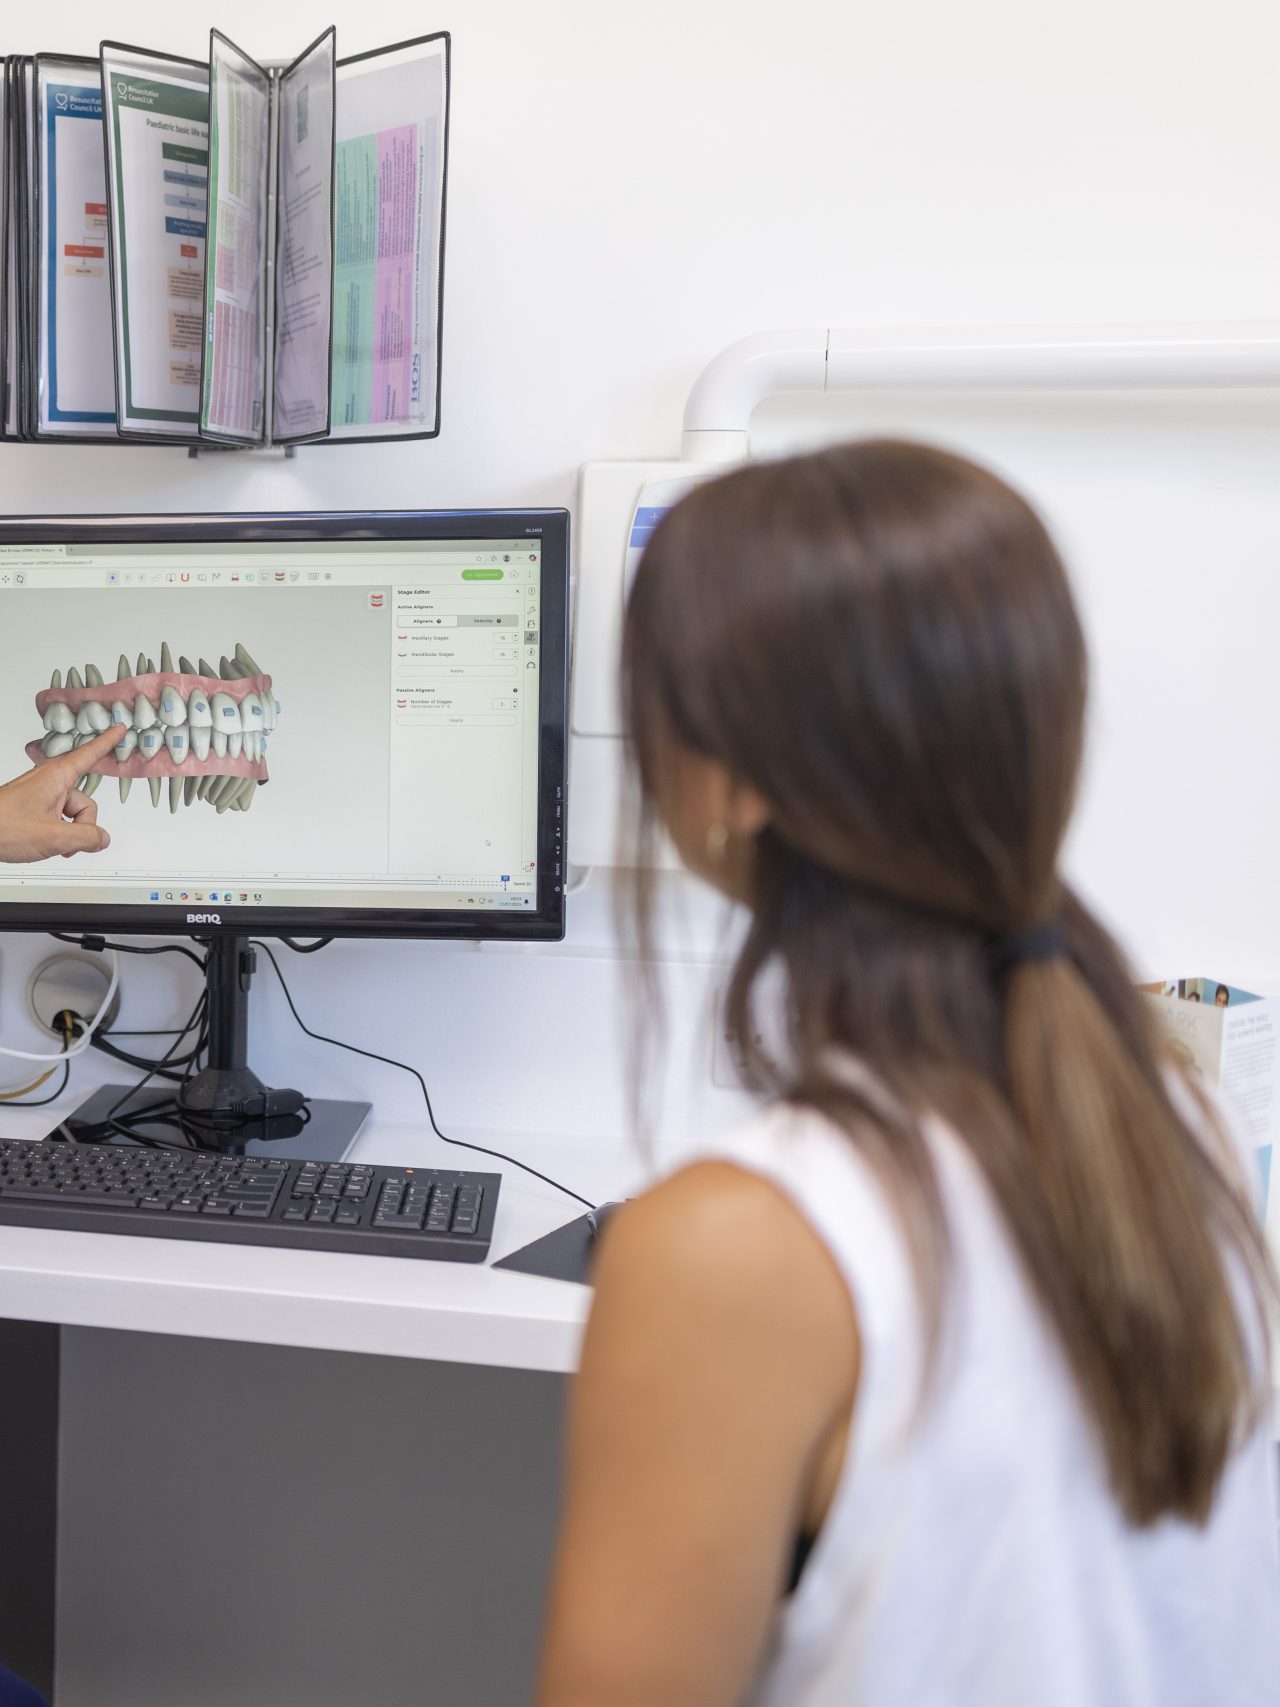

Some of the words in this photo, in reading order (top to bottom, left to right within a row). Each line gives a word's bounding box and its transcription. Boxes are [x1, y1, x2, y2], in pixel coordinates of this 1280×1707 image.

[146, 118, 175, 132] Paediatric
[176, 123, 191, 135] basic
[186, 913, 222, 925] BenQ
